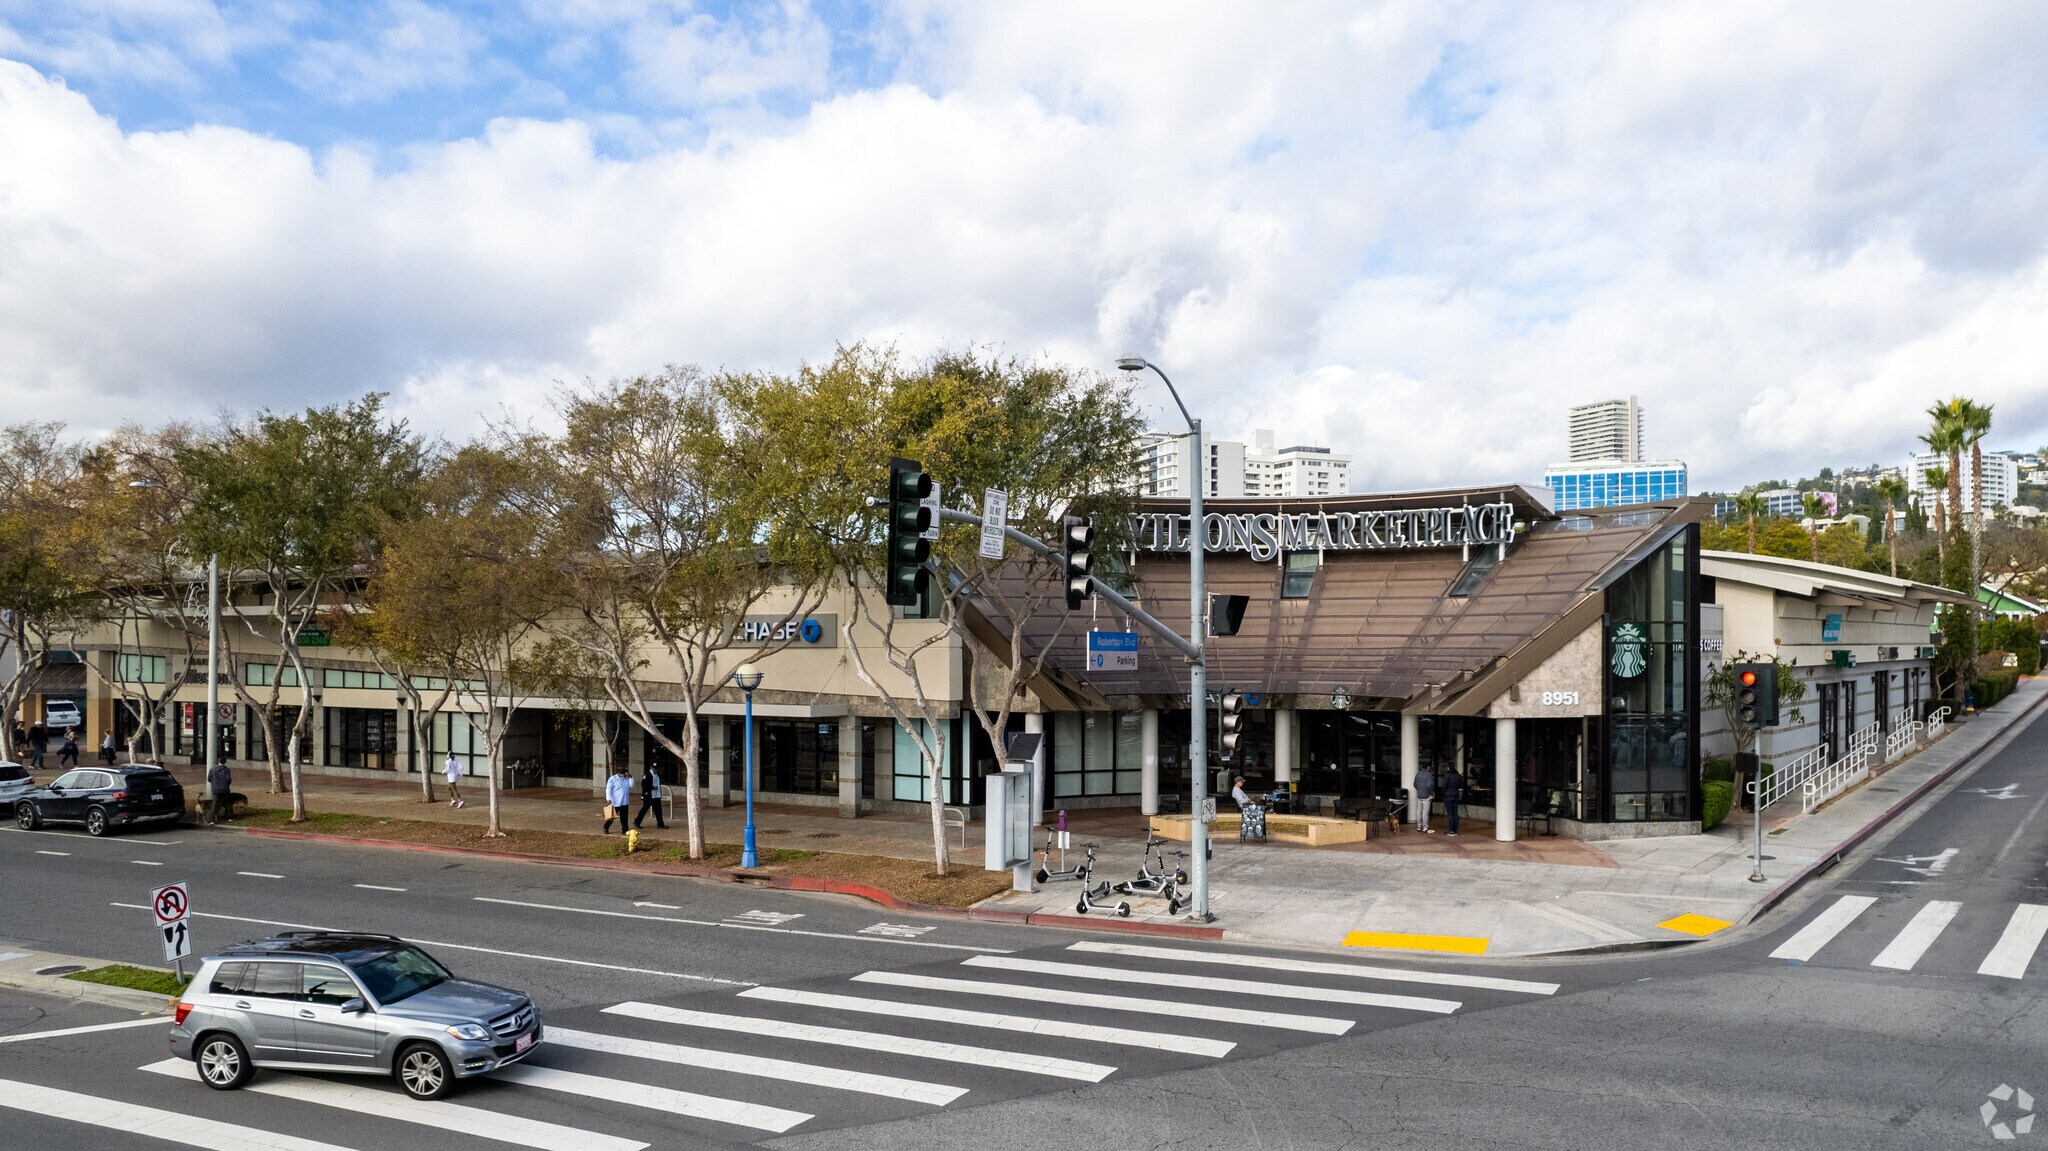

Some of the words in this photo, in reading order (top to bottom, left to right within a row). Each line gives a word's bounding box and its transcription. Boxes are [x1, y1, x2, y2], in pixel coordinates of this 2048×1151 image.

[1089, 512, 1279, 561] VILONS
[1280, 503, 1515, 551] MARKETPLACE
[1098, 636, 1122, 647] Robertson
[1117, 656, 1135, 667] Parking
[1542, 691, 1579, 706] 8951
